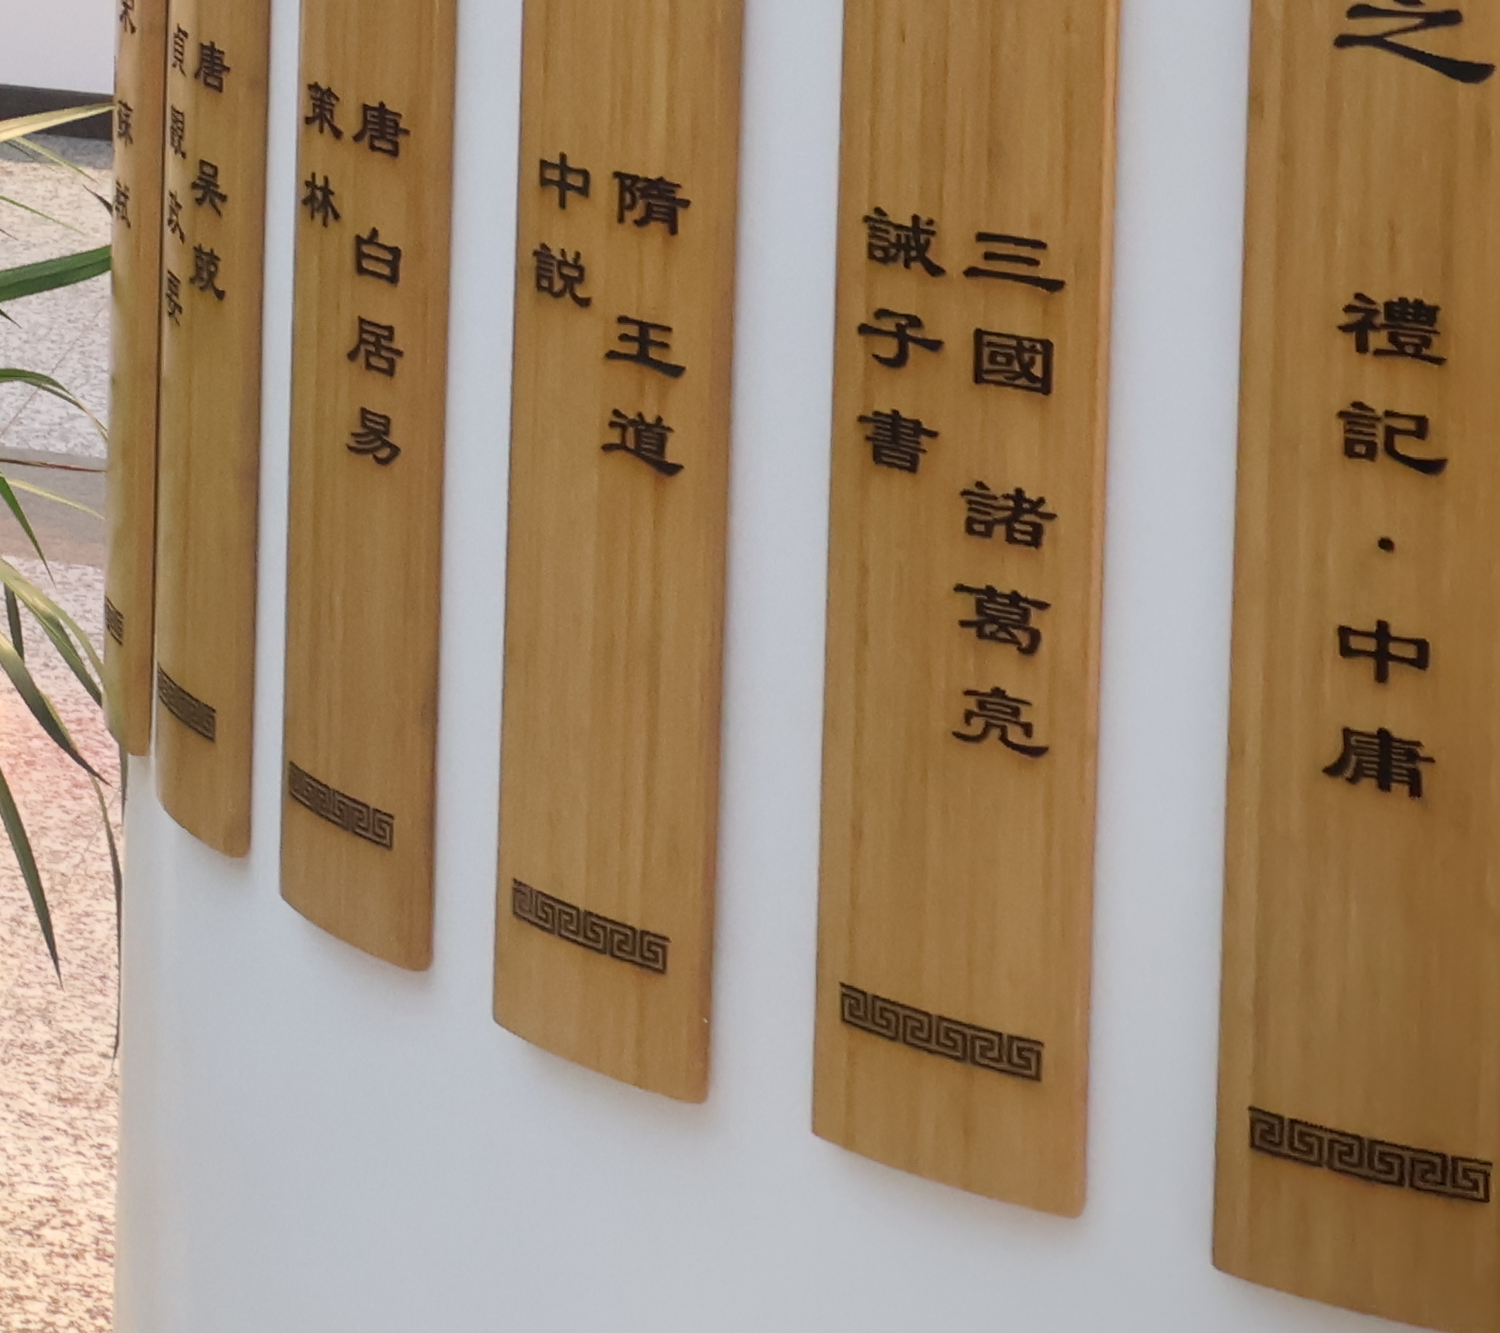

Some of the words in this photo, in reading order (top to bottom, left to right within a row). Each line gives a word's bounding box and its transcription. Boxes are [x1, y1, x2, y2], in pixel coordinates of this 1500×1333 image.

[194, 40, 231, 93] 唐
[353, 100, 410, 158] 唐
[611, 170, 692, 235] 隋
[346, 228, 405, 465] 白居易
[962, 231, 1066, 396] 三國
[951, 480, 1057, 757] 諸葛亮
